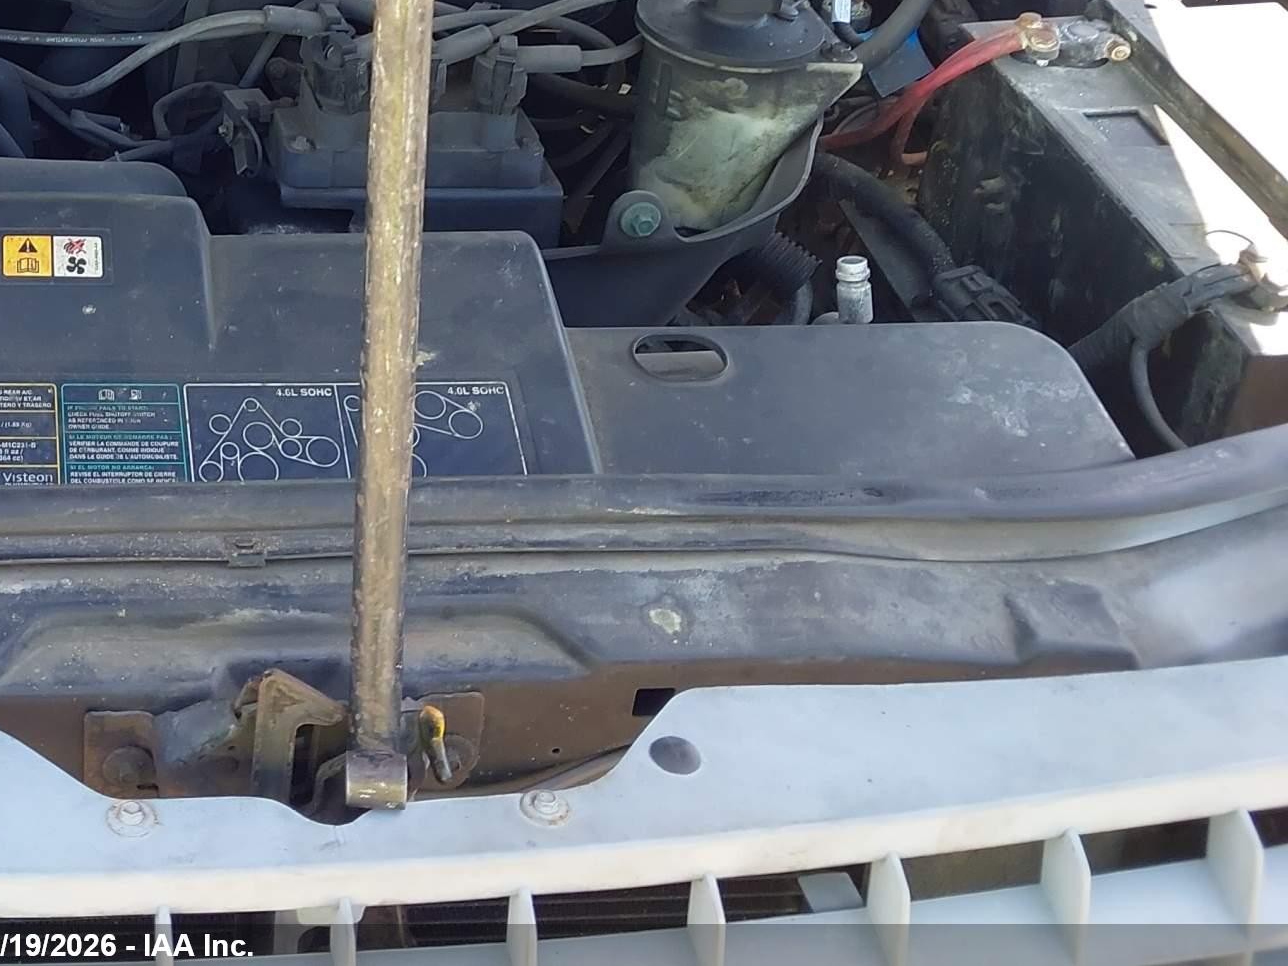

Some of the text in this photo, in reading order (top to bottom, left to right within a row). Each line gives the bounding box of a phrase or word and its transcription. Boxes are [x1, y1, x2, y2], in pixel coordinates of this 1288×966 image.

[299, 388, 332, 397] SOHC
[447, 386, 504, 395] 4.0L SOHC
[2, 472, 53, 483] Visteon
